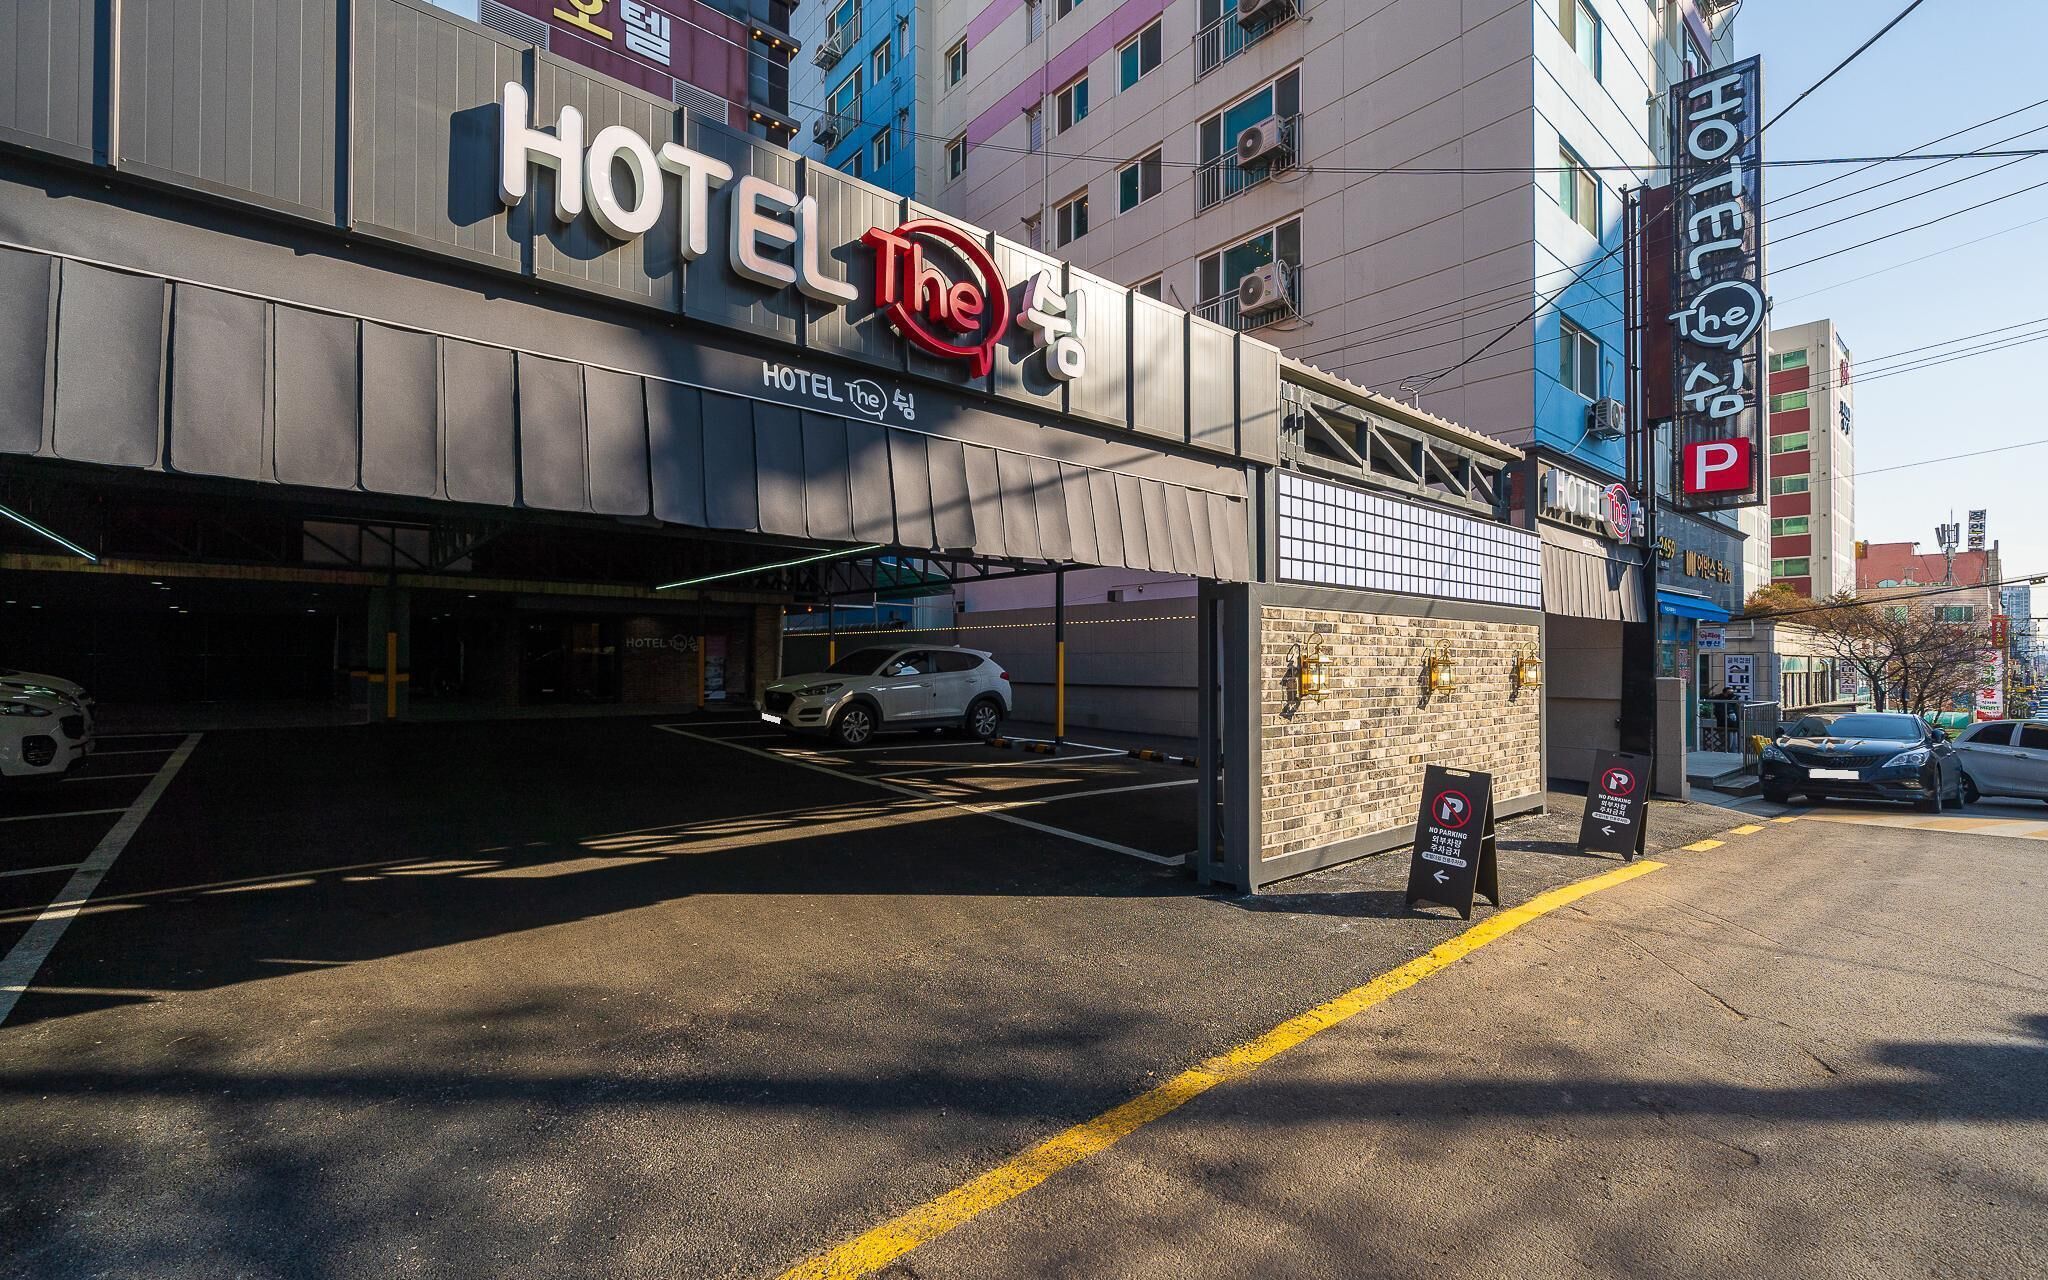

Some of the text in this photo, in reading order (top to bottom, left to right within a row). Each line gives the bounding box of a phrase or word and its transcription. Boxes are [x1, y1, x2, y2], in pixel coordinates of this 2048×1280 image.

[499, 81, 859, 301] HOTEL
[861, 226, 985, 334] The
[1668, 73, 1749, 419] HOTEL The 쉼
[762, 361, 844, 403] HOTEL
[1695, 443, 1739, 490] P
[1547, 467, 1605, 522] HOTEL
[625, 638, 667, 648] HOTEL
[1606, 795, 1632, 805] PARKING
[1428, 826, 1468, 840] NO PARKING
[1430, 843, 1461, 857] 주차금지
